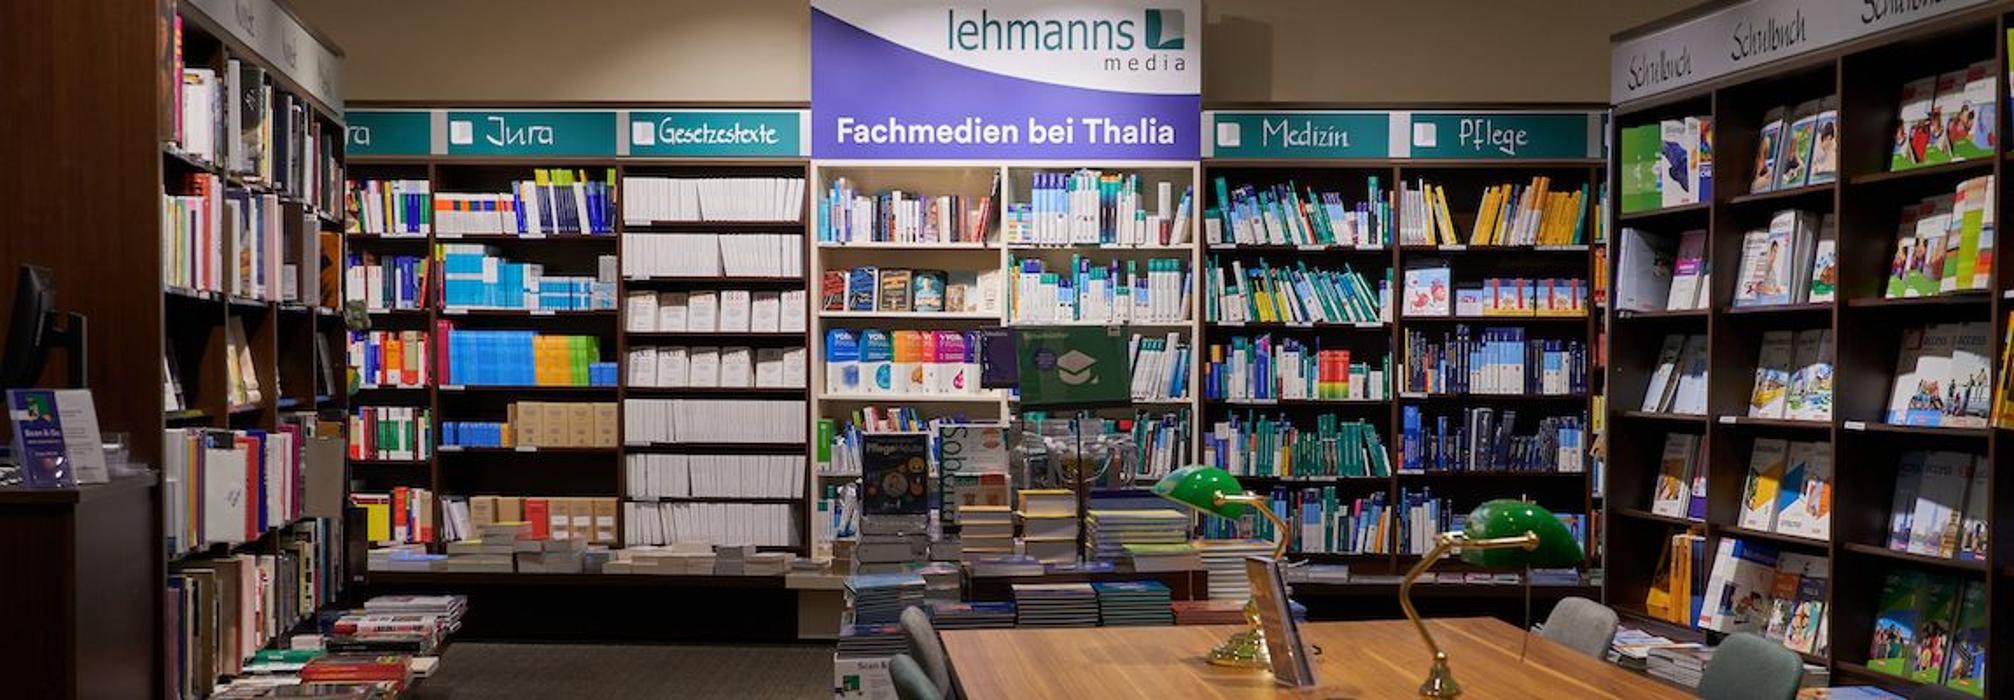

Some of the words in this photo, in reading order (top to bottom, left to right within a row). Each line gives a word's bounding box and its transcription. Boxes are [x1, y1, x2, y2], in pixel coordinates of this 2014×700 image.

[948, 8, 1135, 51] lehmanns
[1730, 9, 1807, 61] Schulbuch
[1104, 55, 1186, 71] media
[344, 124, 370, 147] ra
[486, 116, 554, 147] Jura
[658, 116, 781, 145] Gesetzestexte
[837, 117, 1019, 144] Fachmedien
[1028, 117, 1074, 144] bei
[1082, 117, 1175, 144] Thalia
[1262, 118, 1350, 148] Medizin
[1459, 118, 1528, 155] Pflege
